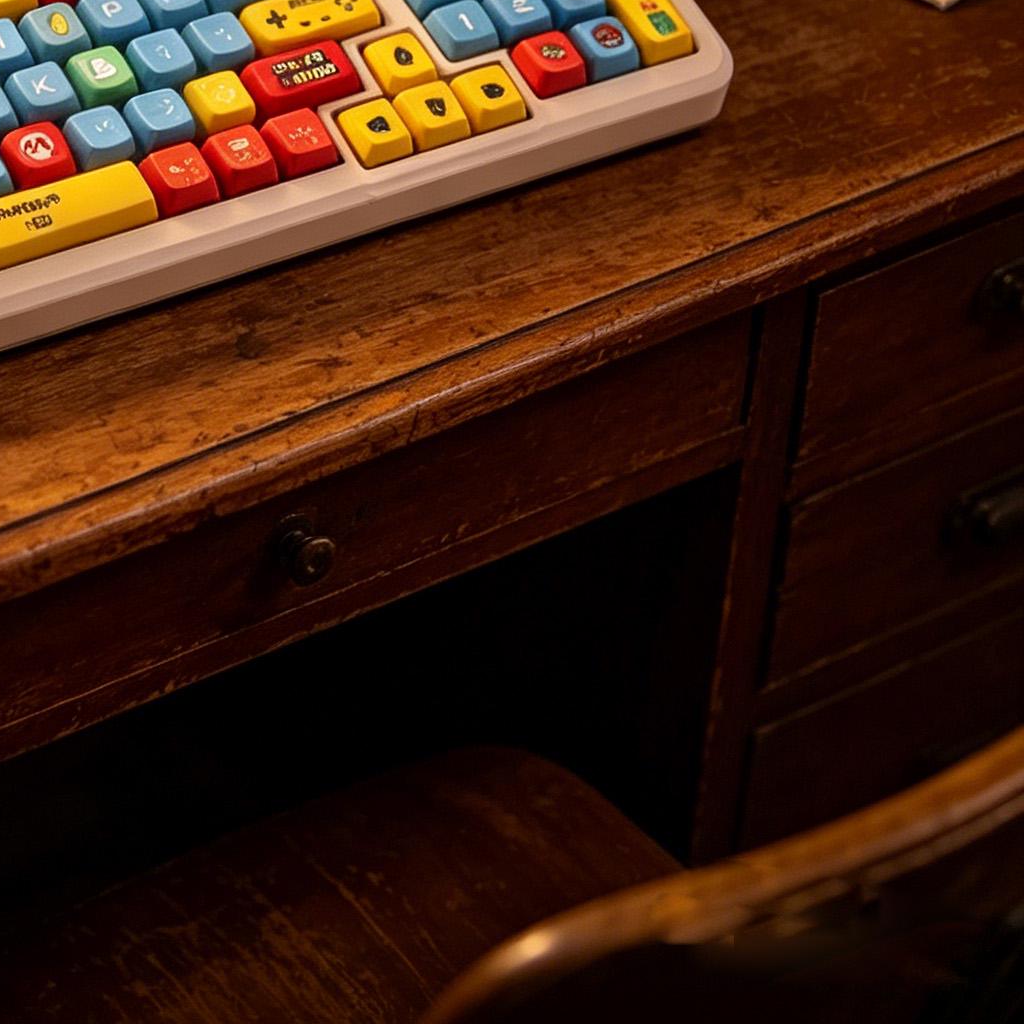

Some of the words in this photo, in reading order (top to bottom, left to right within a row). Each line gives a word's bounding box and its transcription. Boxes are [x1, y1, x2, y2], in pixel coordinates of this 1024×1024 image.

[101, 0, 122, 18] P
[458, 13, 474, 31] 1
[31, 75, 56, 95] K
